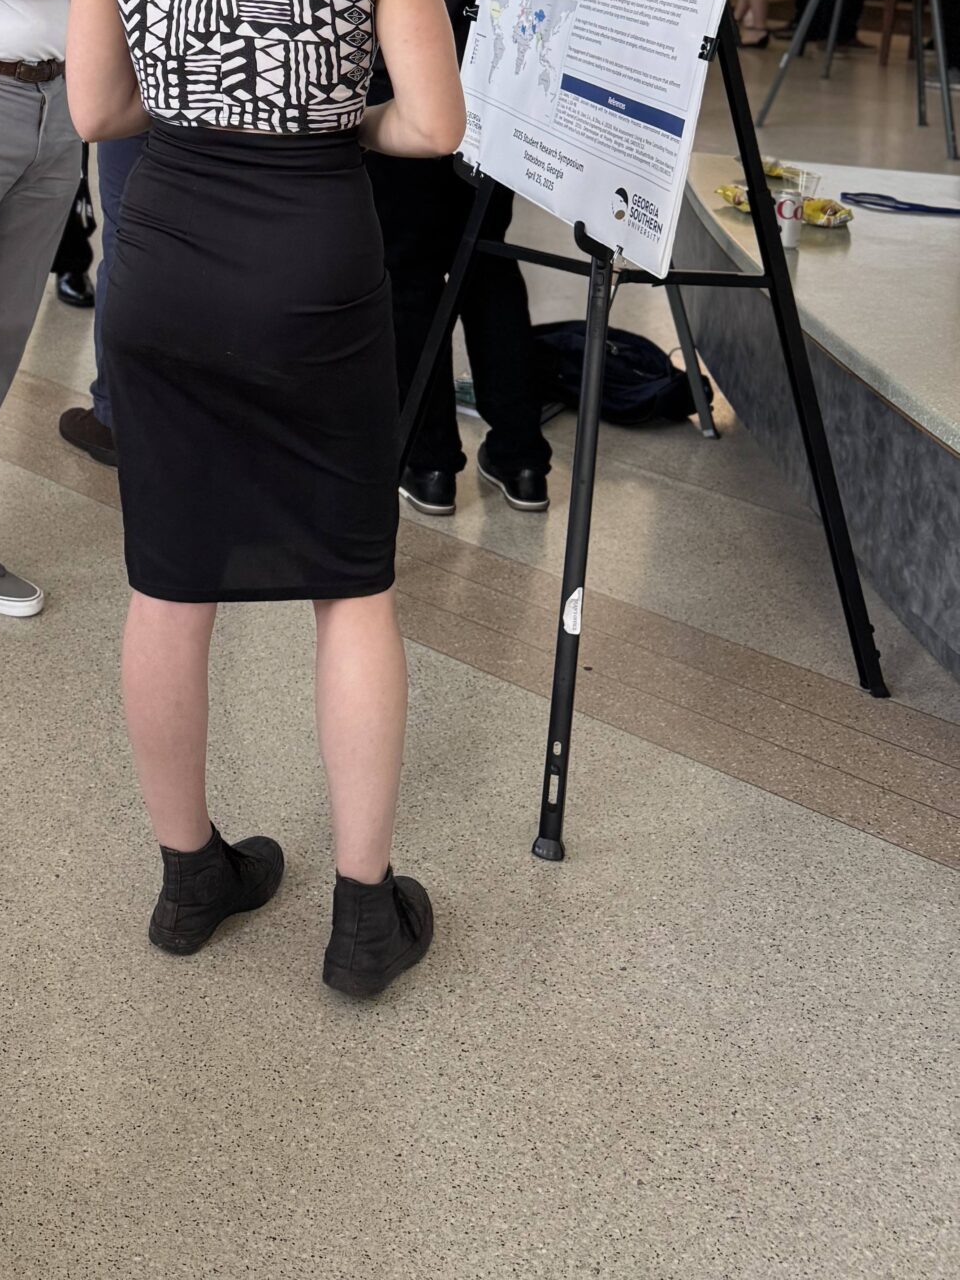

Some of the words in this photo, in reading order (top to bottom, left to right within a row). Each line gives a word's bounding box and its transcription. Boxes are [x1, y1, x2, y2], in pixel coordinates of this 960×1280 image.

[607, 96, 626, 110] References
[513, 128, 524, 141] 2025
[523, 133, 539, 149] Student
[539, 141, 558, 158] Research
[557, 151, 584, 172] Symposium
[523, 150, 546, 171] Statesboro,
[546, 162, 564, 179] Georgia
[525, 168, 536, 181] April
[535, 173, 543, 186] 25,
[542, 177, 554, 191] 2025
[632, 193, 659, 219] GEORGIA
[627, 220, 661, 244] UNIVERSITY
[629, 207, 663, 235] SOUTHERN
